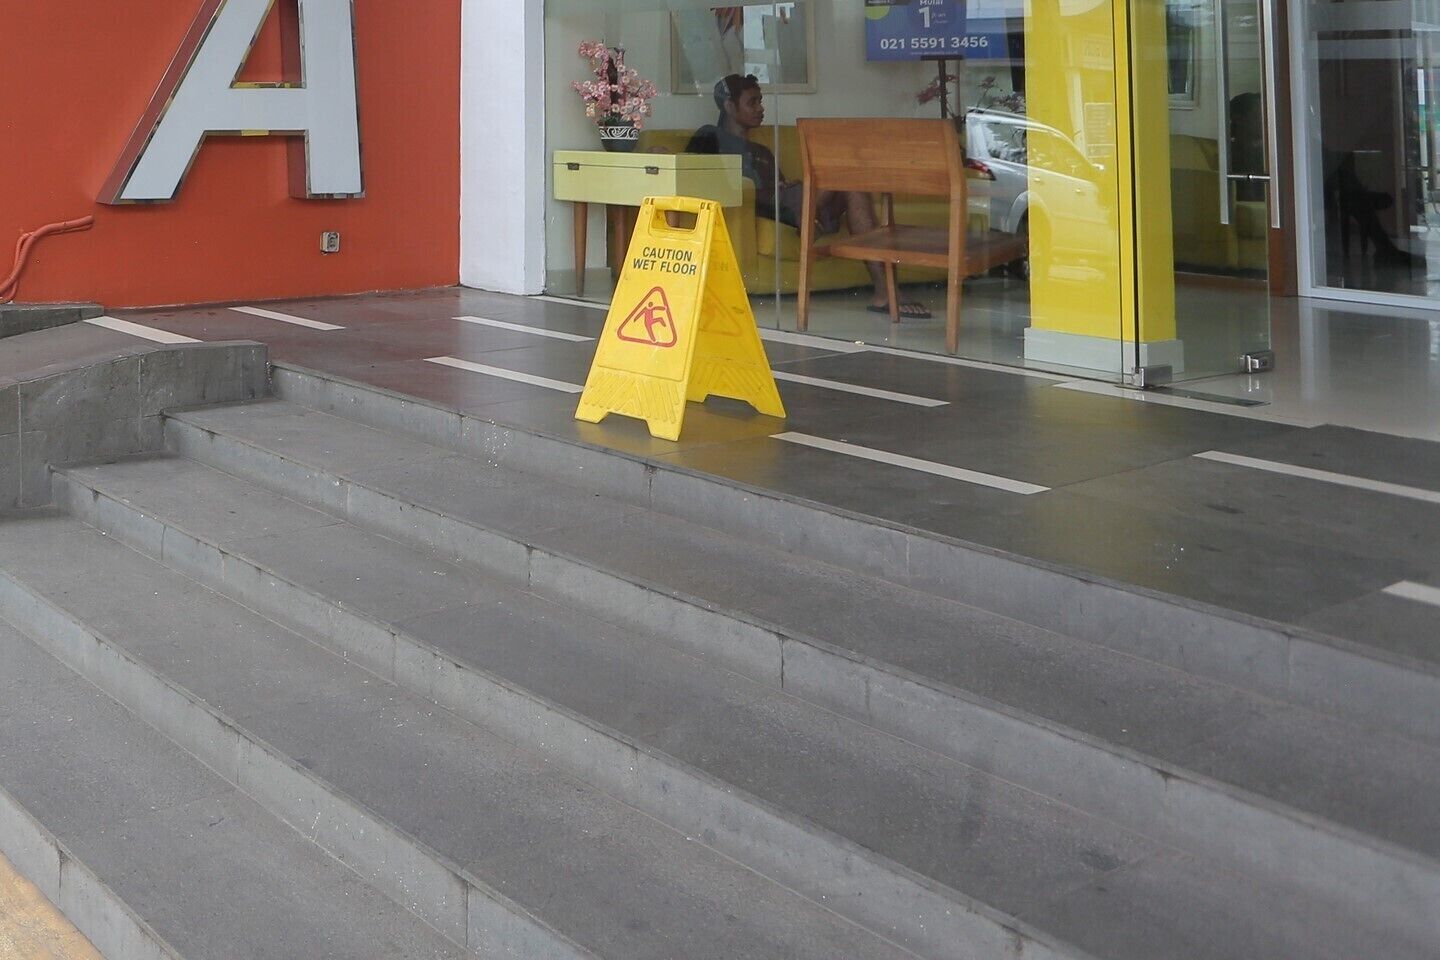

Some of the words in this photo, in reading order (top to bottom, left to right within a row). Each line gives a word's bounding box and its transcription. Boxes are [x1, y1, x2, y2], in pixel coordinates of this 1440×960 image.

[918, 6, 931, 28] 1
[880, 38, 905, 50] 021
[910, 37, 945, 49] 5591
[951, 36, 988, 48] 3456
[642, 246, 693, 262] CAUTION
[633, 258, 656, 271] WET
[660, 261, 697, 275] FLOOR
